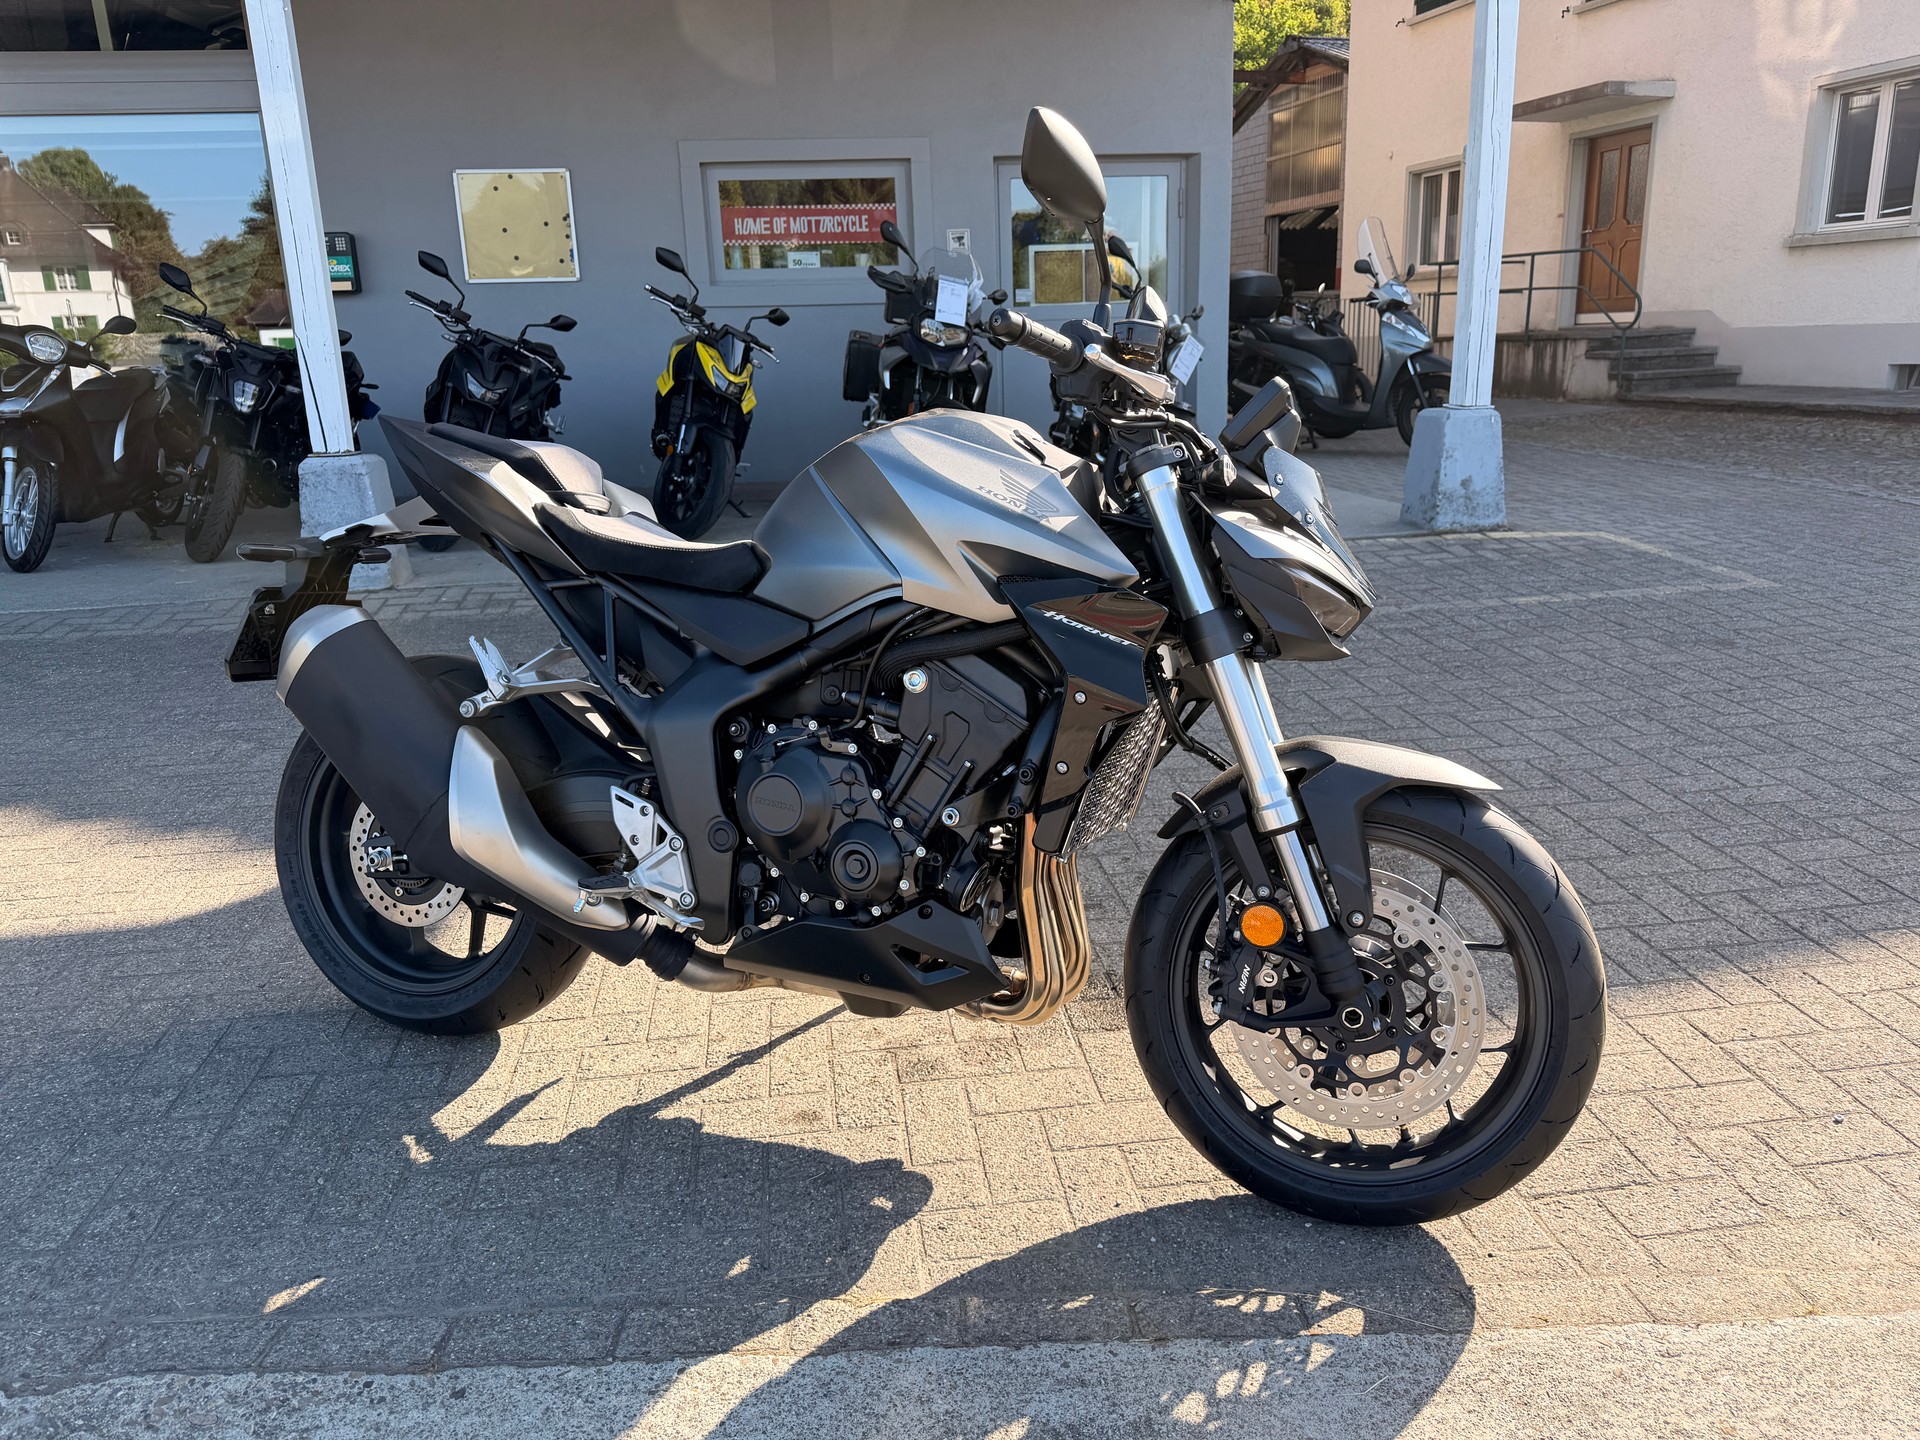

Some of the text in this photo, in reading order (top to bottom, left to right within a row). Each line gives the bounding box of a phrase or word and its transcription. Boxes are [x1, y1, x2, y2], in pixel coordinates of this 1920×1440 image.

[734, 217, 771, 236] HOME
[773, 217, 787, 235] OF
[792, 259, 802, 267] 50
[976, 485, 1051, 524] HONDA
[755, 796, 798, 813] HONDA
